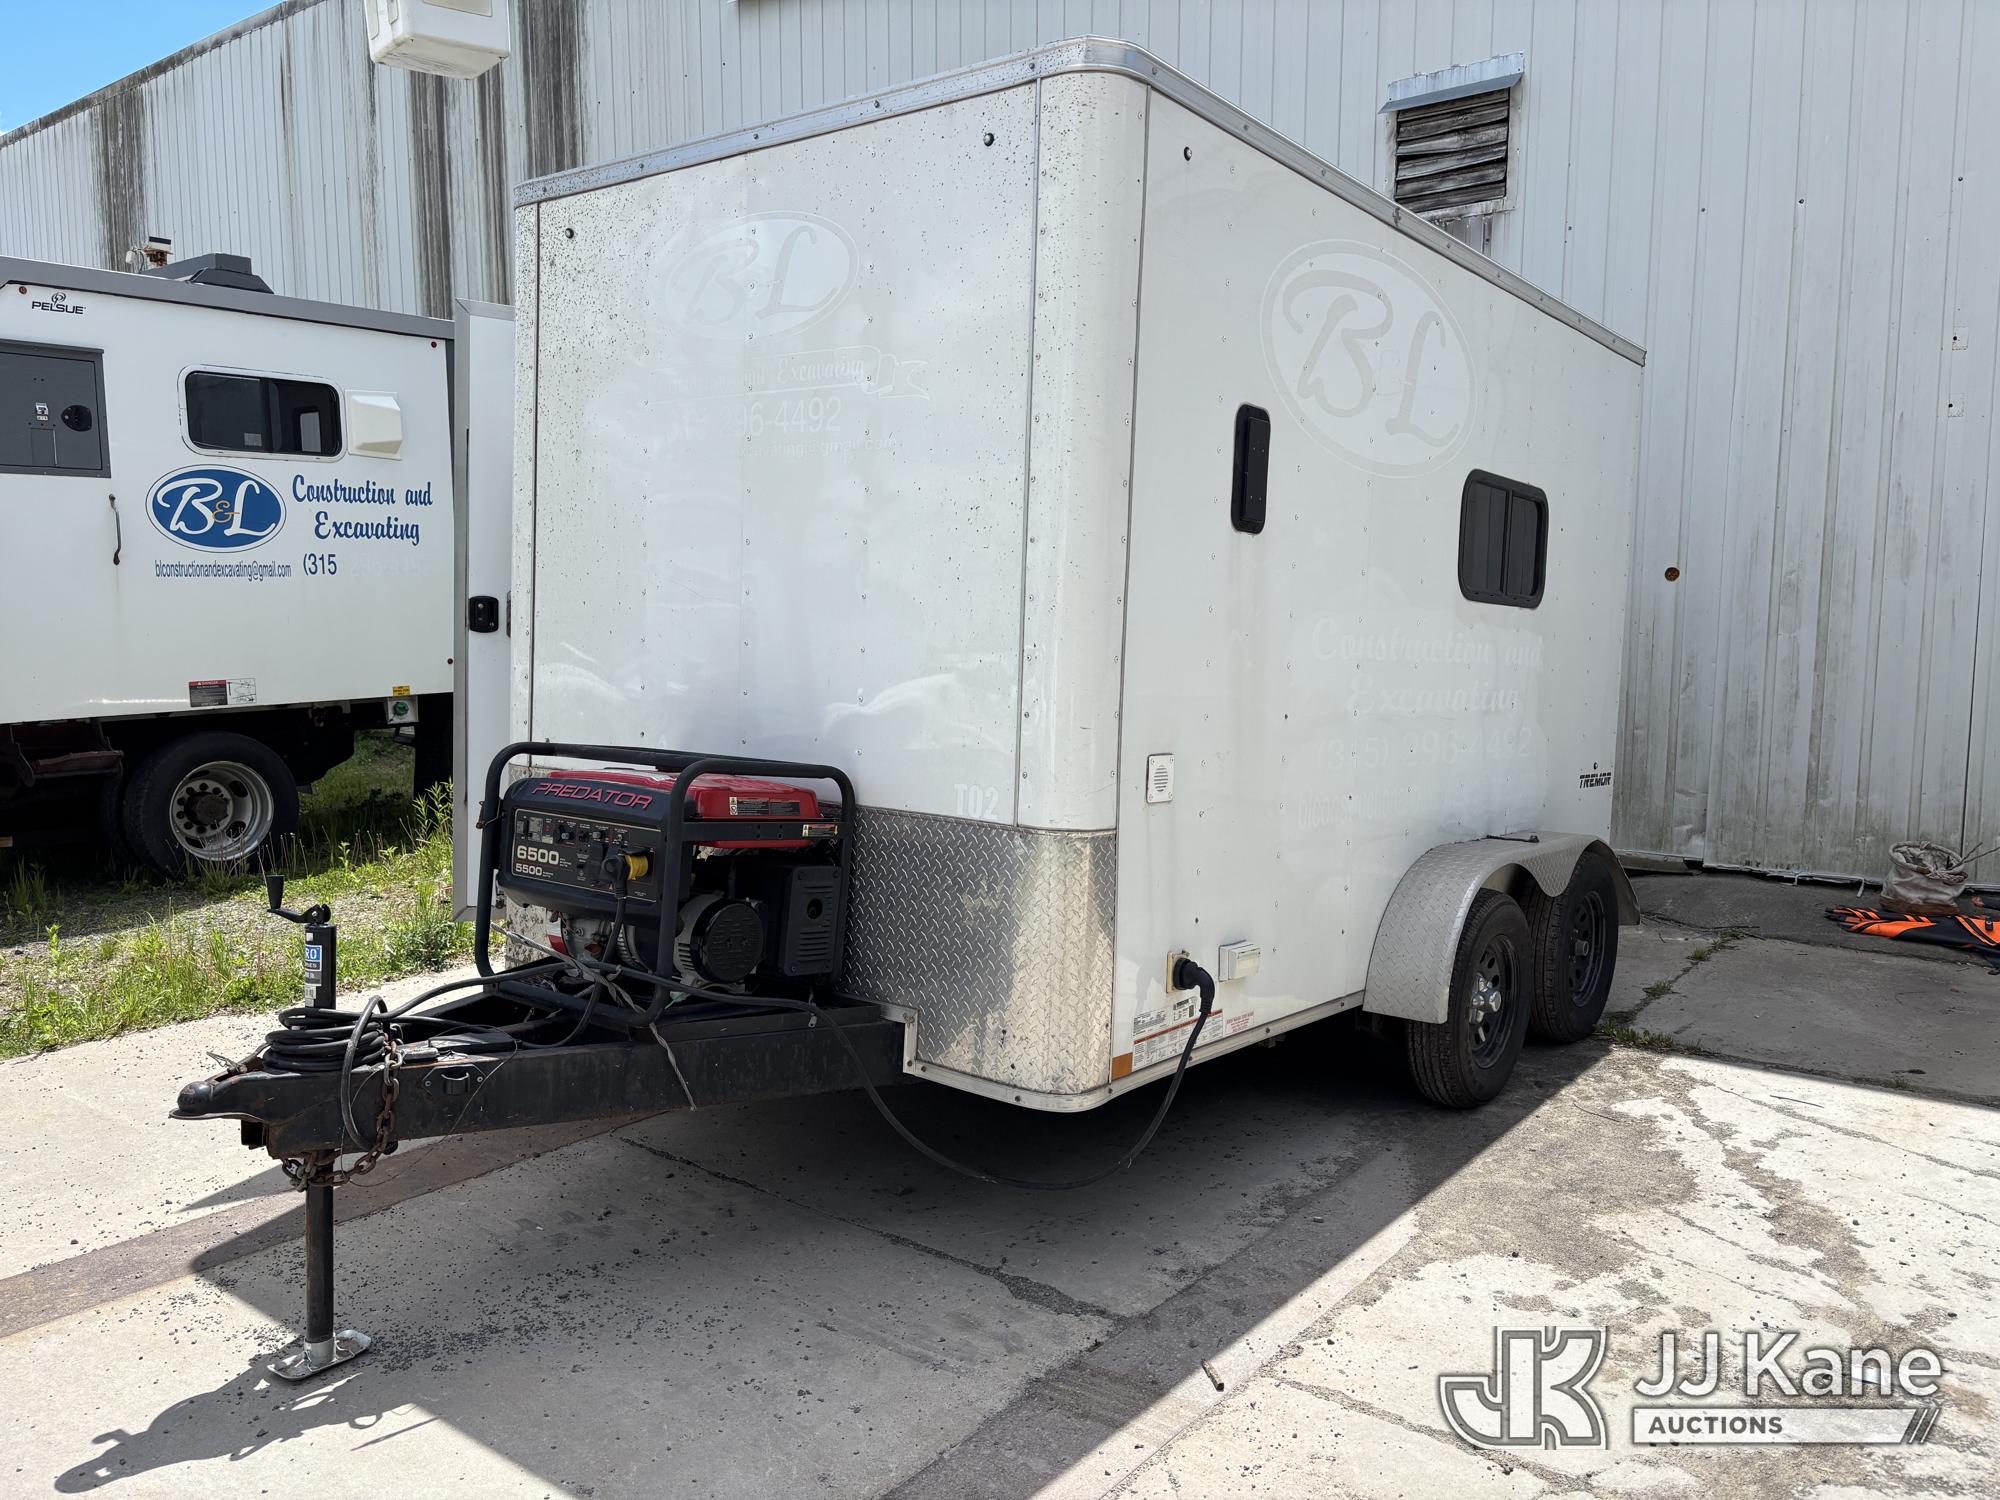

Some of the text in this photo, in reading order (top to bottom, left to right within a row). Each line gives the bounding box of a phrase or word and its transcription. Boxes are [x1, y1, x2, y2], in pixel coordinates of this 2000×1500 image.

[31, 301, 84, 315] PELSUE
[291, 475, 433, 507] Construction and
[157, 477, 277, 538] B&L
[314, 512, 421, 547] Excavating
[154, 559, 292, 582] blconstructionandexcavating@gmail.com
[302, 553, 338, 577] (315
[1311, 617, 1493, 663] Construction
[1579, 771, 1612, 789] TREMOR
[531, 782, 654, 811] PREDATOR
[516, 845, 560, 866] 6500
[515, 862, 543, 877] 5500
